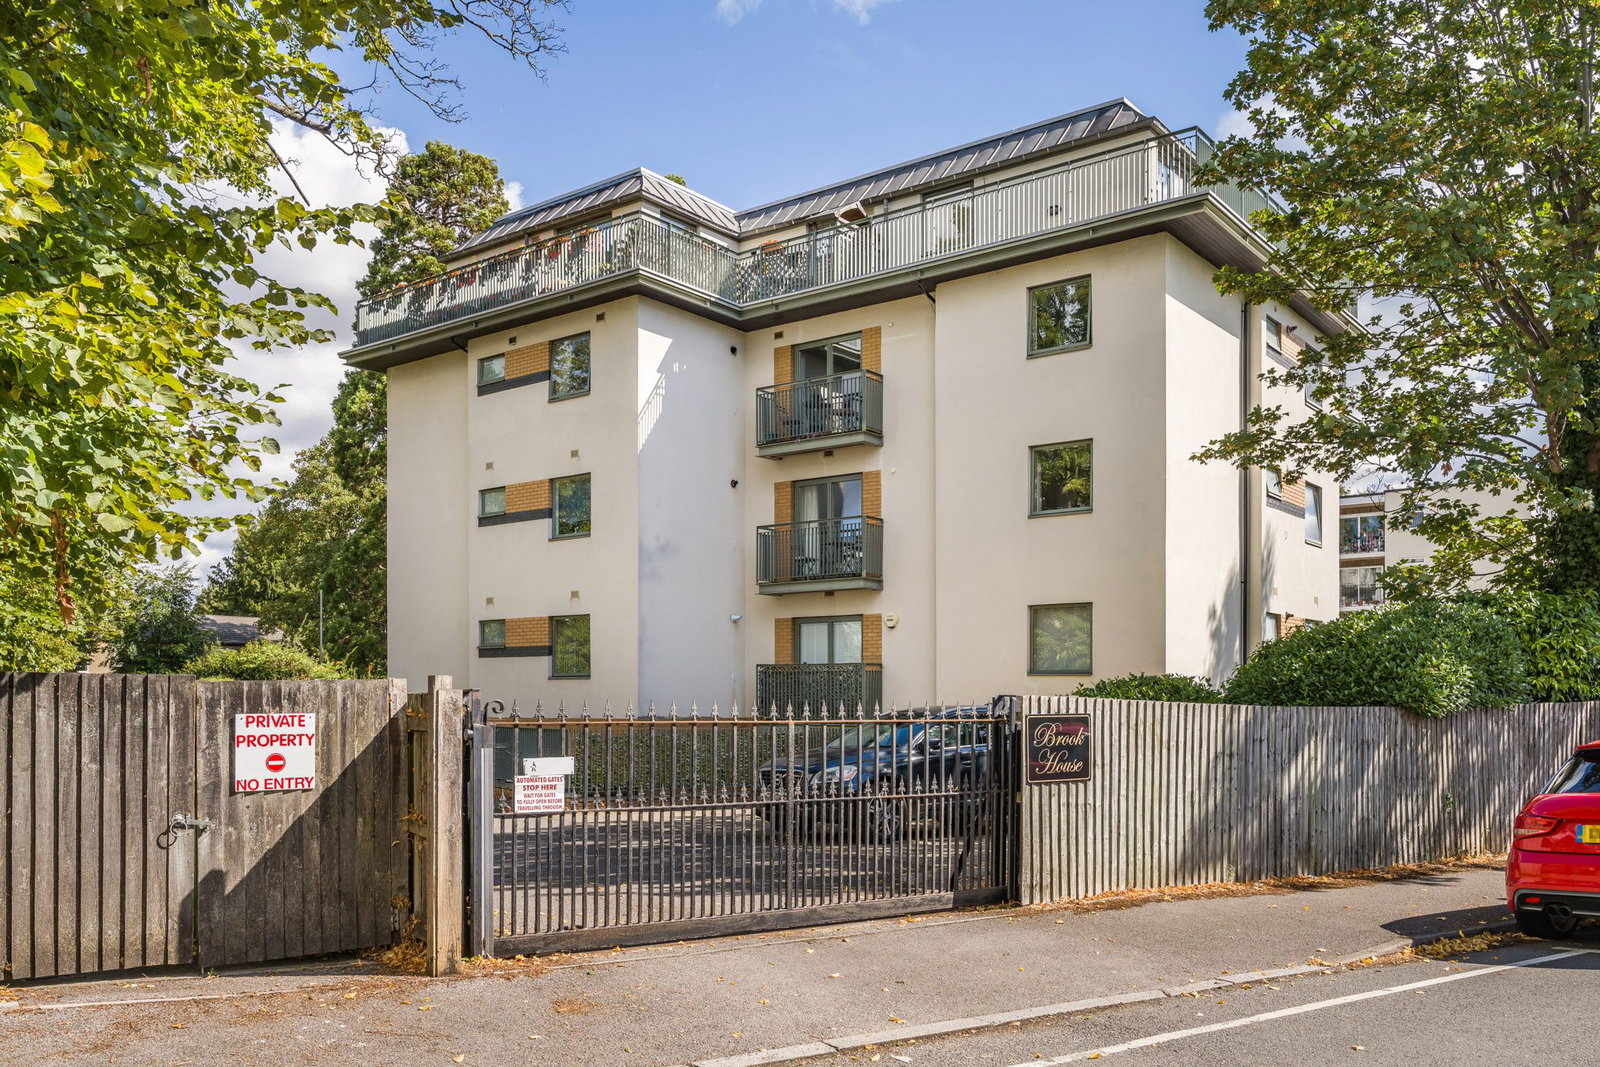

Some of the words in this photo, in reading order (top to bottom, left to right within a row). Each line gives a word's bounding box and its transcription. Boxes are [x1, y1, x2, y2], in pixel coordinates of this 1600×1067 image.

[245, 715, 306, 728] PRIVATE
[236, 733, 315, 748] PROPERTY
[1033, 722, 1085, 747] Brook
[1035, 748, 1083, 774] House
[236, 779, 259, 791] NO
[264, 777, 314, 790] ENTRY
